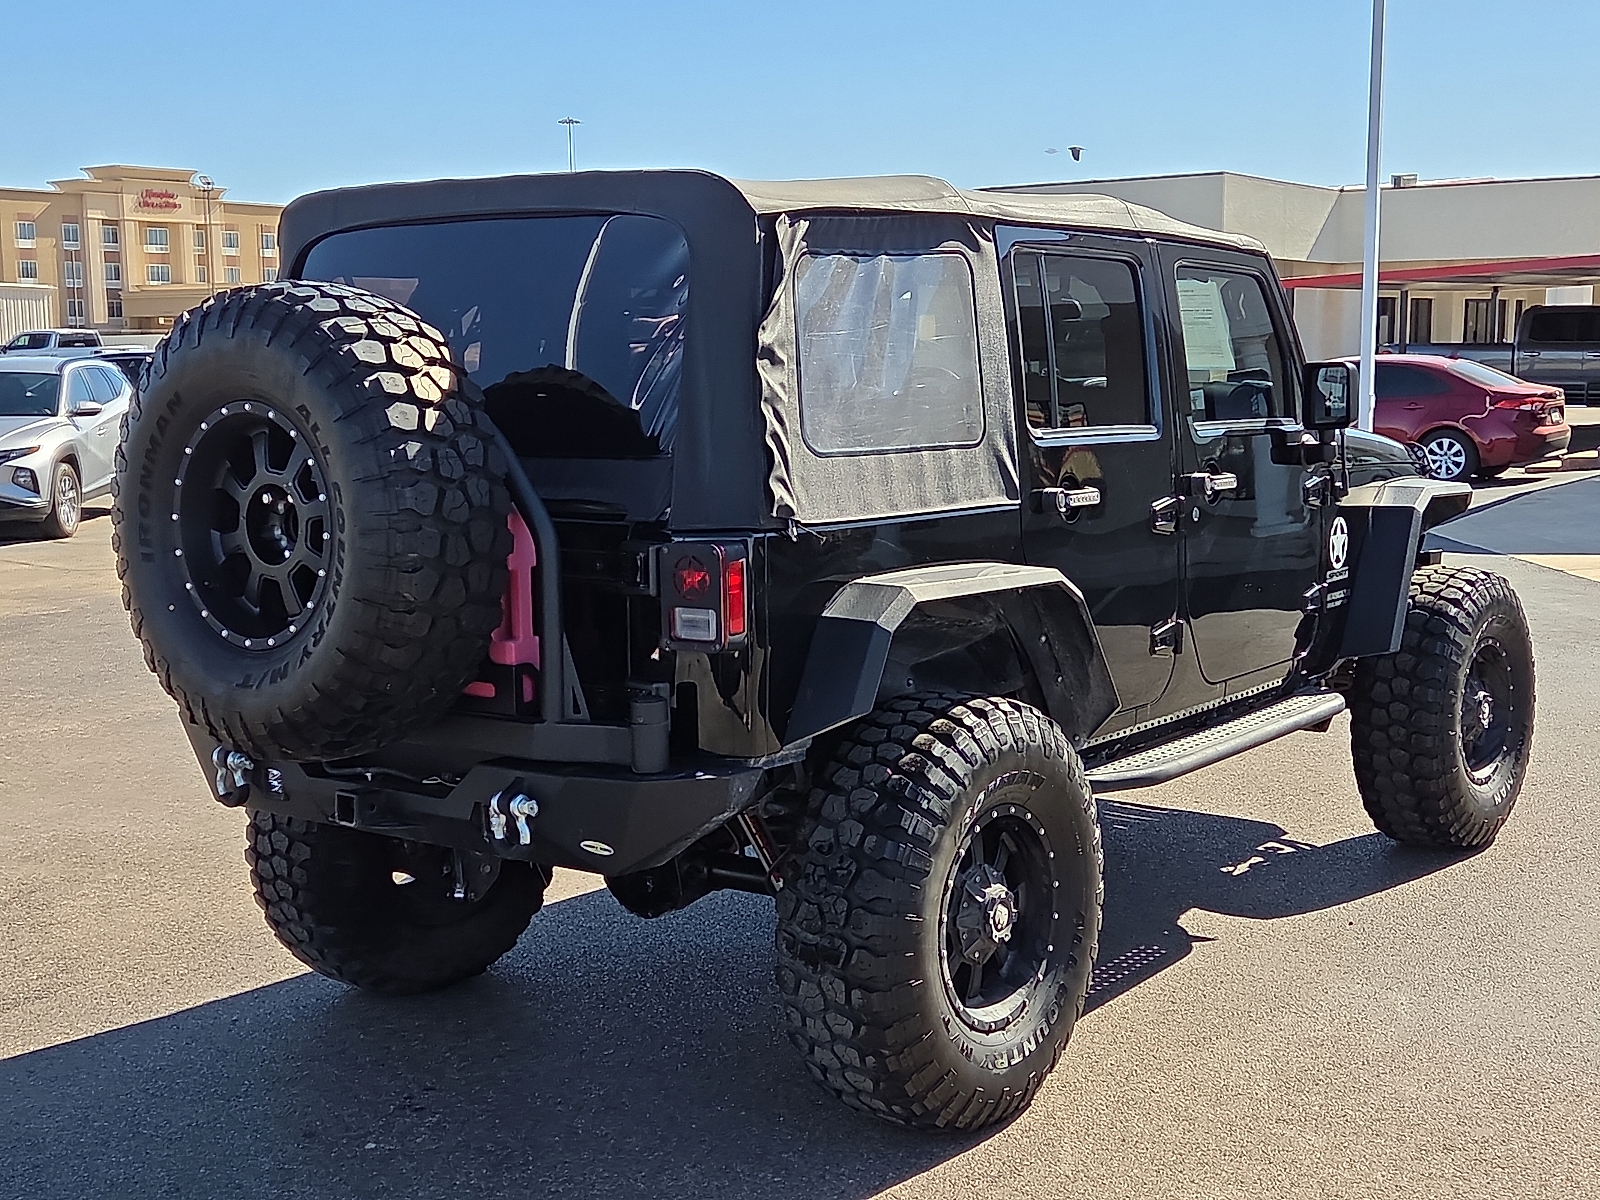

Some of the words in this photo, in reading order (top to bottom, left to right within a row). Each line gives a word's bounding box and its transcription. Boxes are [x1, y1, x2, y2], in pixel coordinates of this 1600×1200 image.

[138, 390, 183, 563] IRONMAN
[295, 403, 332, 468] ALL
[297, 480, 347, 670] COUNTRY
[234, 660, 291, 690] M/T
